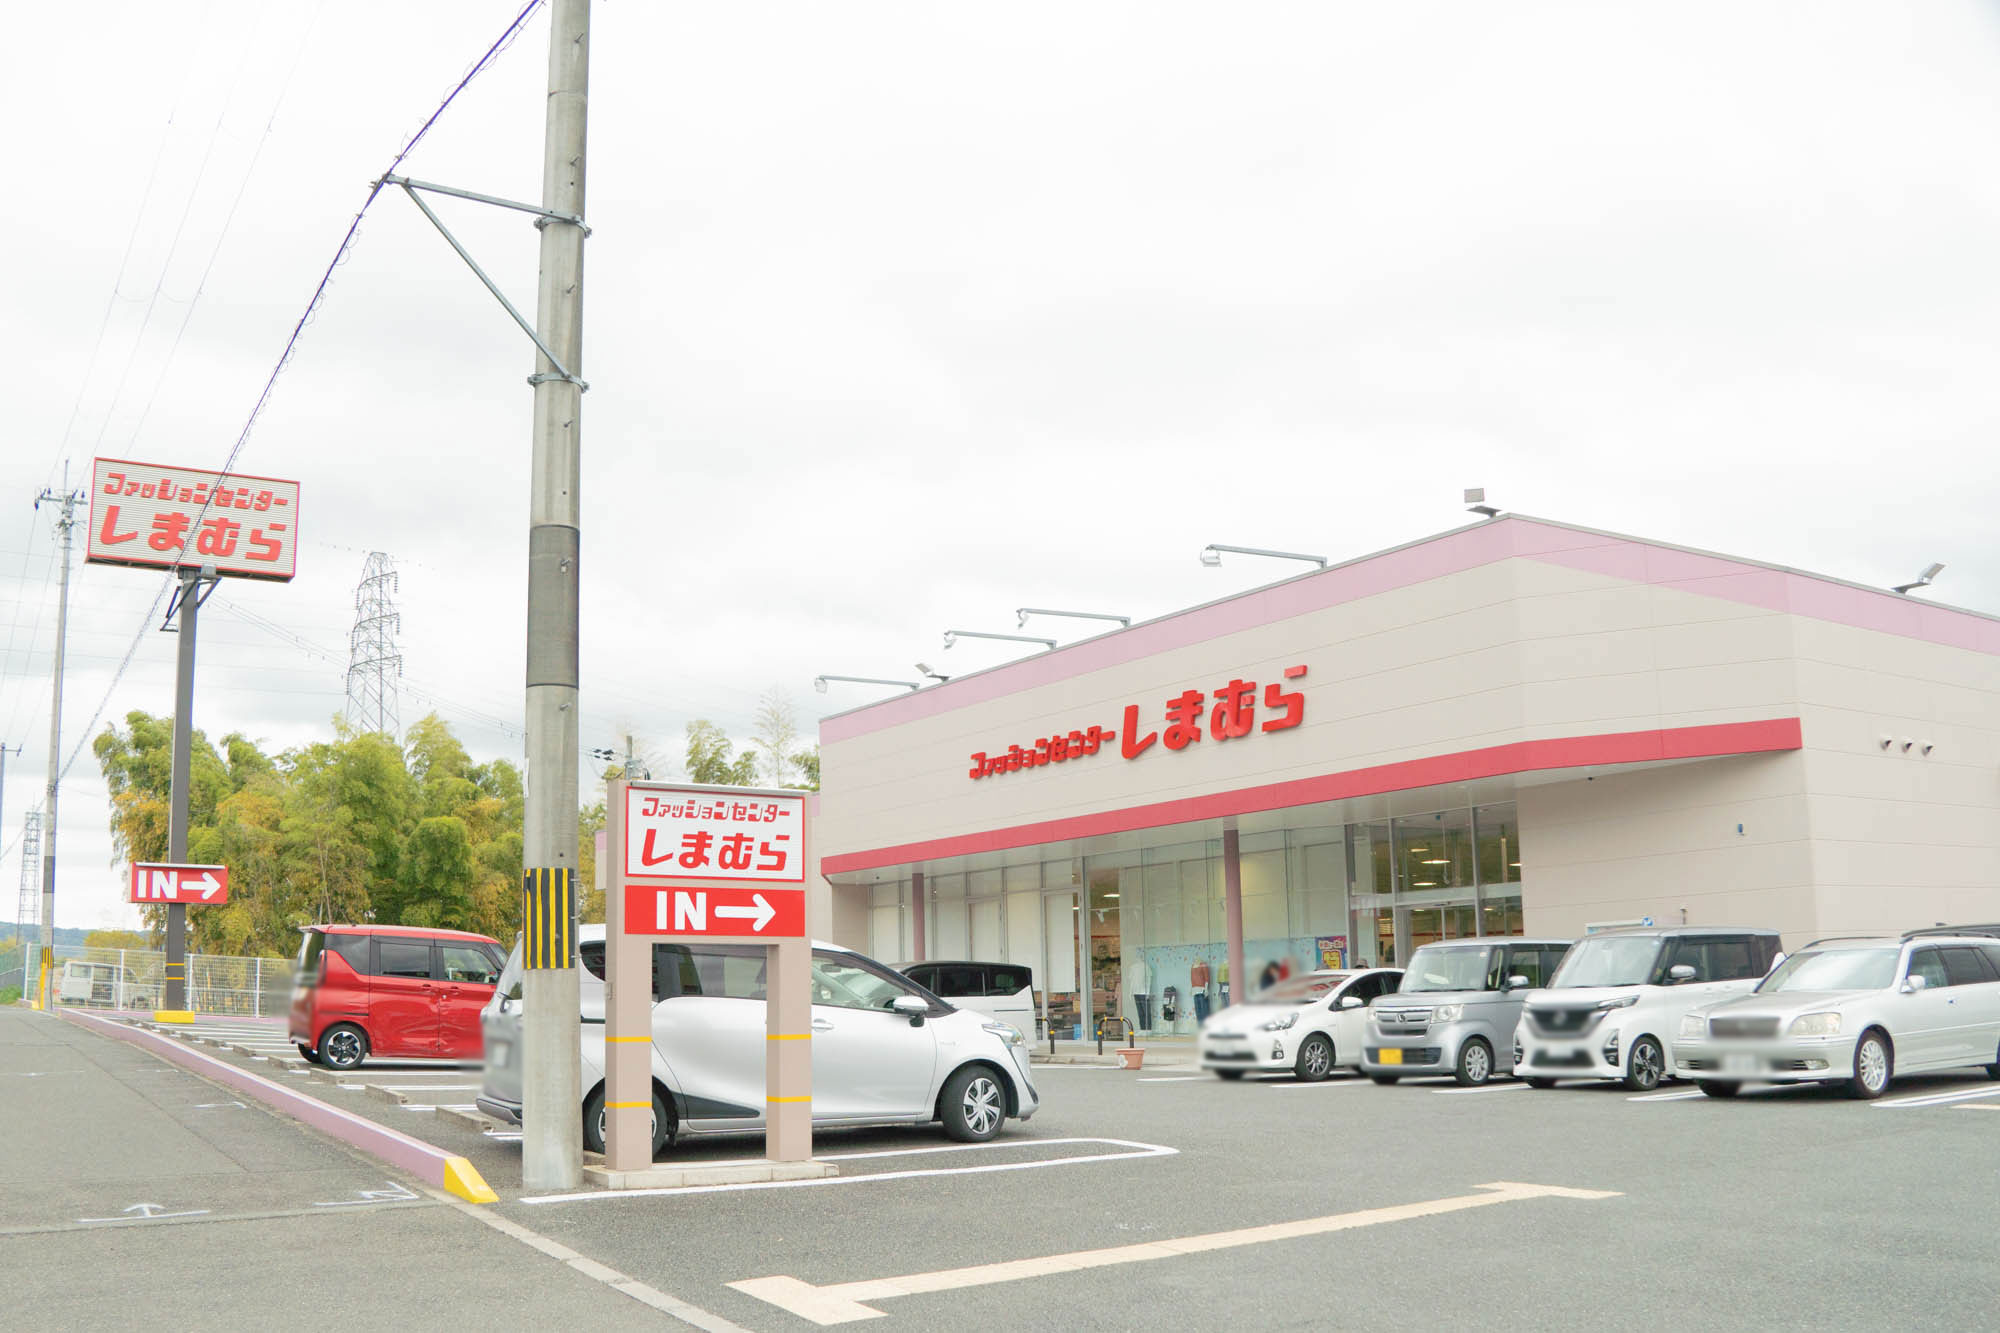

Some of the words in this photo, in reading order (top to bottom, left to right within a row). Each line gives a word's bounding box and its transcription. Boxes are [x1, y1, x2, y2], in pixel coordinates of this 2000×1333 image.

[103, 472, 288, 511] ファッションセンター
[100, 505, 287, 562] しまむら
[969, 725, 1116, 779] ファッションセンター
[1121, 665, 1308, 760] しまむら
[642, 797, 790, 823] ファッションセンター
[641, 828, 790, 871] しまむら
[136, 870, 178, 899] IN
[656, 890, 707, 931] IN
